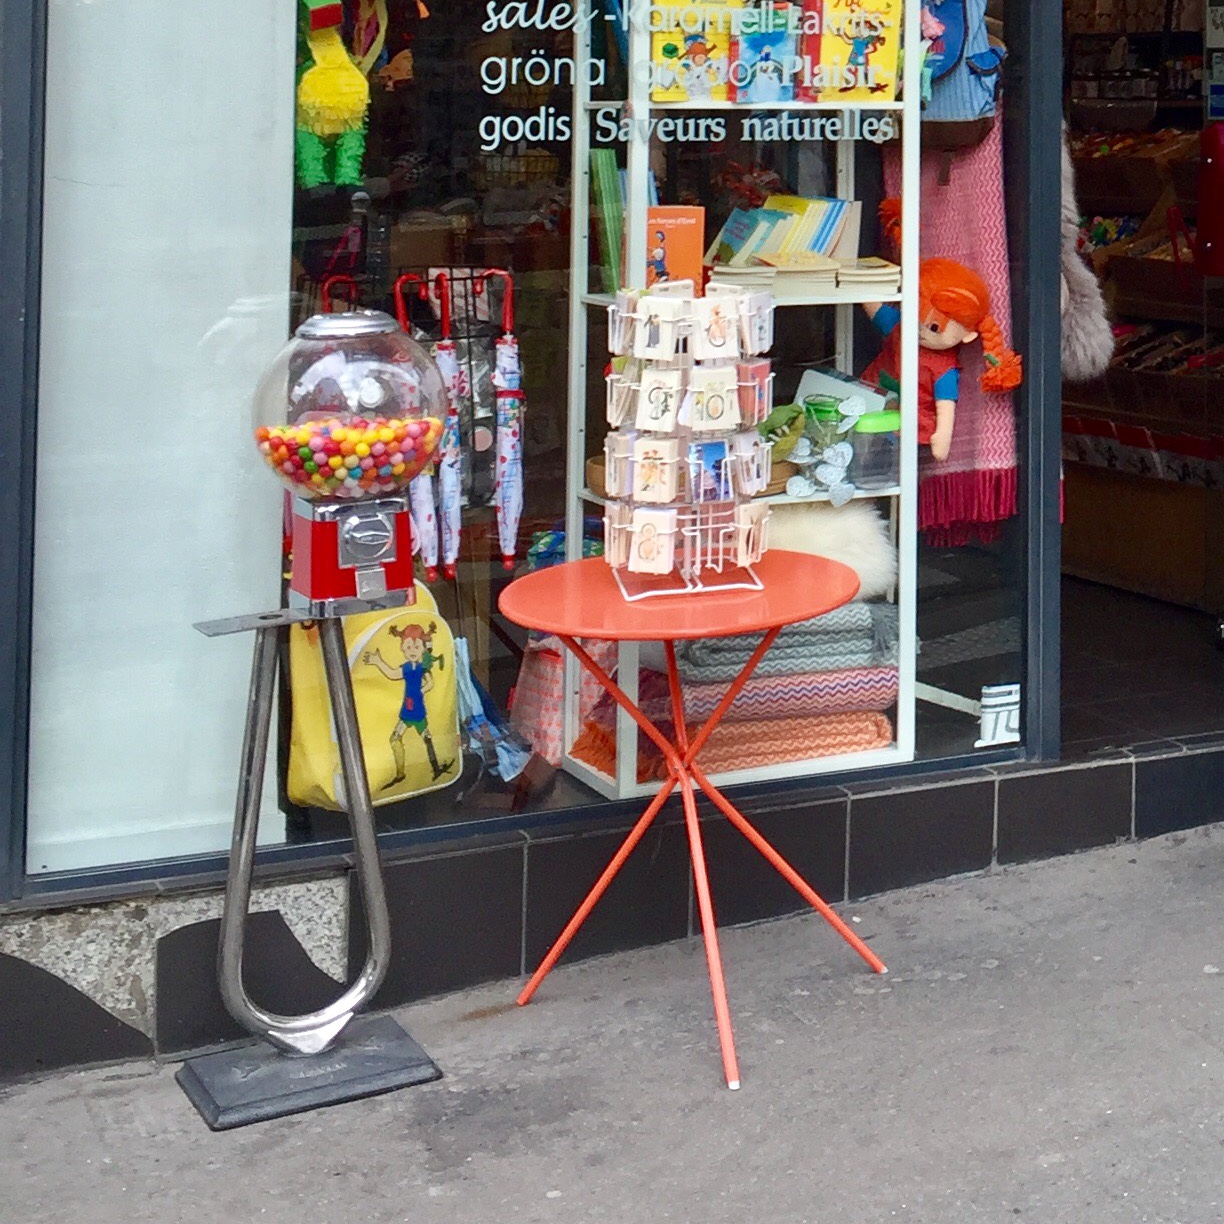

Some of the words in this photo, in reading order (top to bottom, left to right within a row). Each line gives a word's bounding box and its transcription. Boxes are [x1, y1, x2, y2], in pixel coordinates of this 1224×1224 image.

[480, 48, 606, 95] gröna
[478, 106, 572, 152] godis
[595, 107, 727, 143] Saveurs
[741, 108, 895, 143] naturelles
